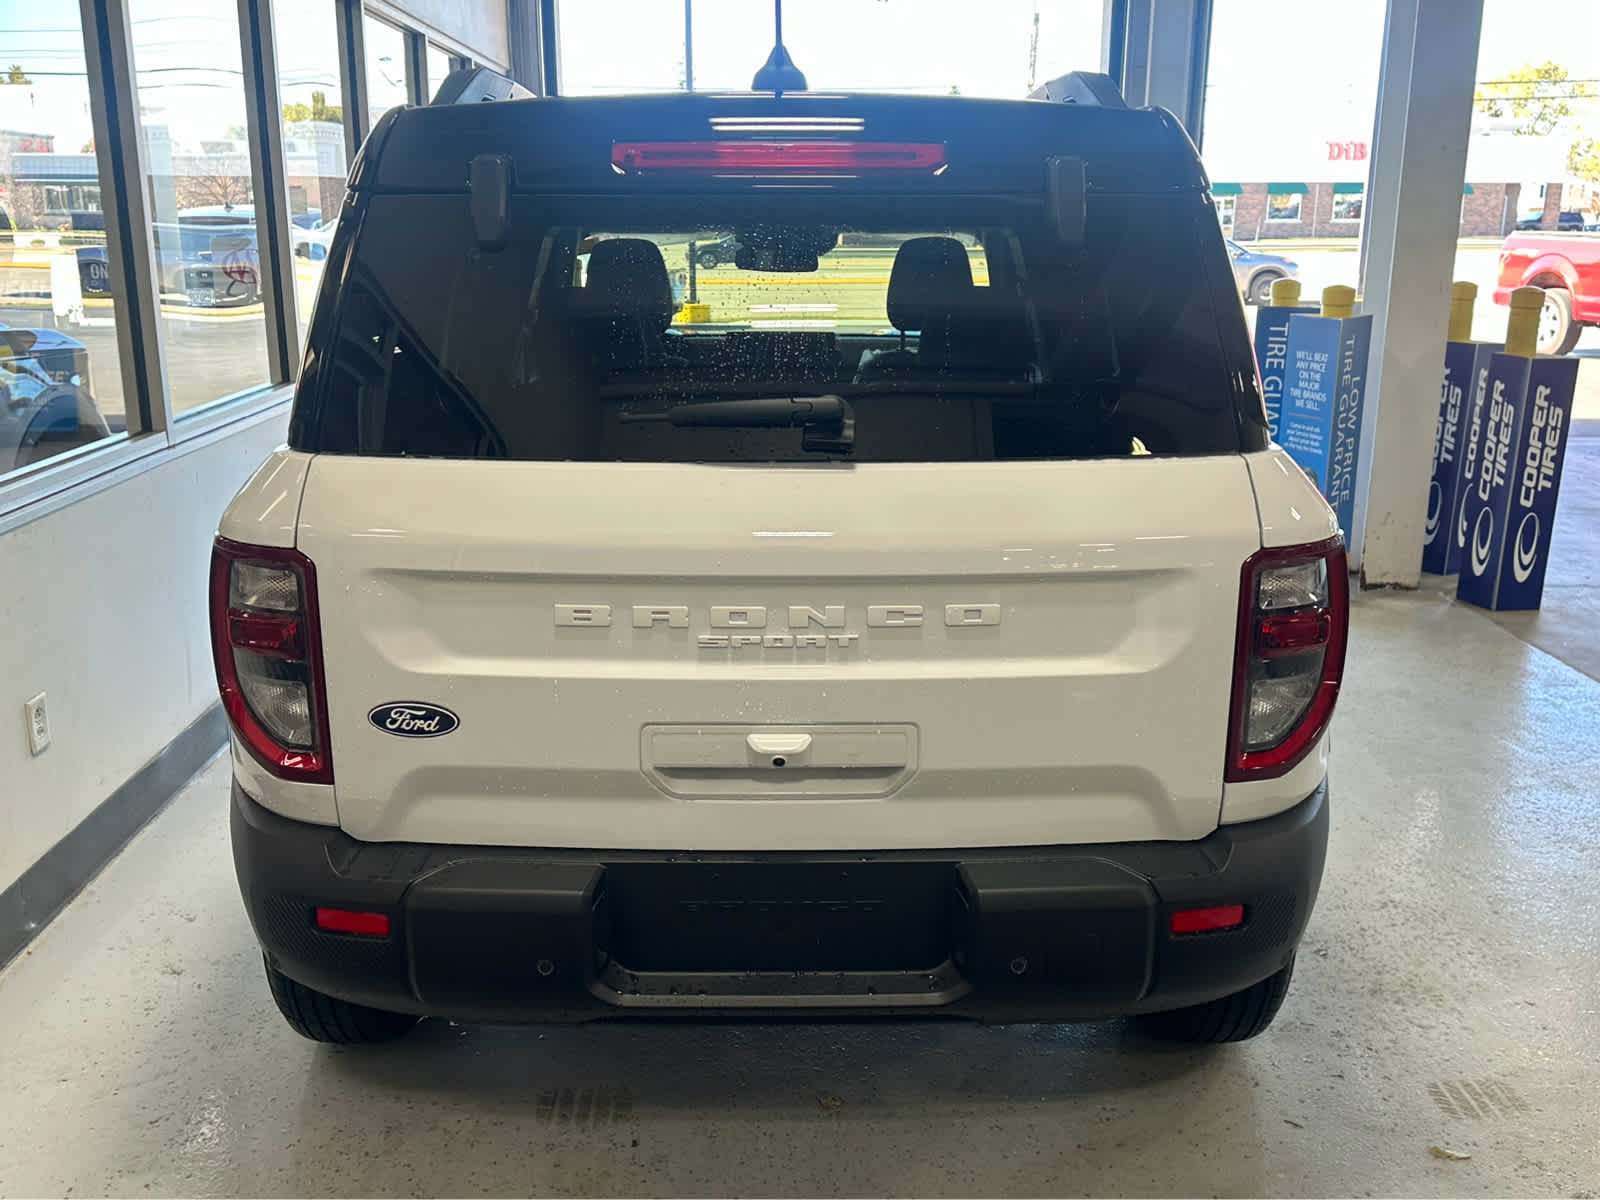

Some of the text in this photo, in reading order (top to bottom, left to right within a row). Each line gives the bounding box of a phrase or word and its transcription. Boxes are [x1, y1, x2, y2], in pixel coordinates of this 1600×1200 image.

[1265, 322, 1288, 369] TIRE
[1342, 336, 1355, 387] TIRE
[1339, 376, 1360, 502] LOW PRICE
[1440, 384, 1462, 463] TIRES
[1464, 368, 1488, 479] COOPER
[1478, 379, 1505, 501] COOPER
[1492, 400, 1515, 487] TIRES
[1520, 384, 1551, 508] COOPER
[1537, 404, 1563, 491] TIRES
[554, 604, 1001, 628] BRONCO
[697, 634, 860, 648] SPORT
[386, 708, 441, 732] Ford
